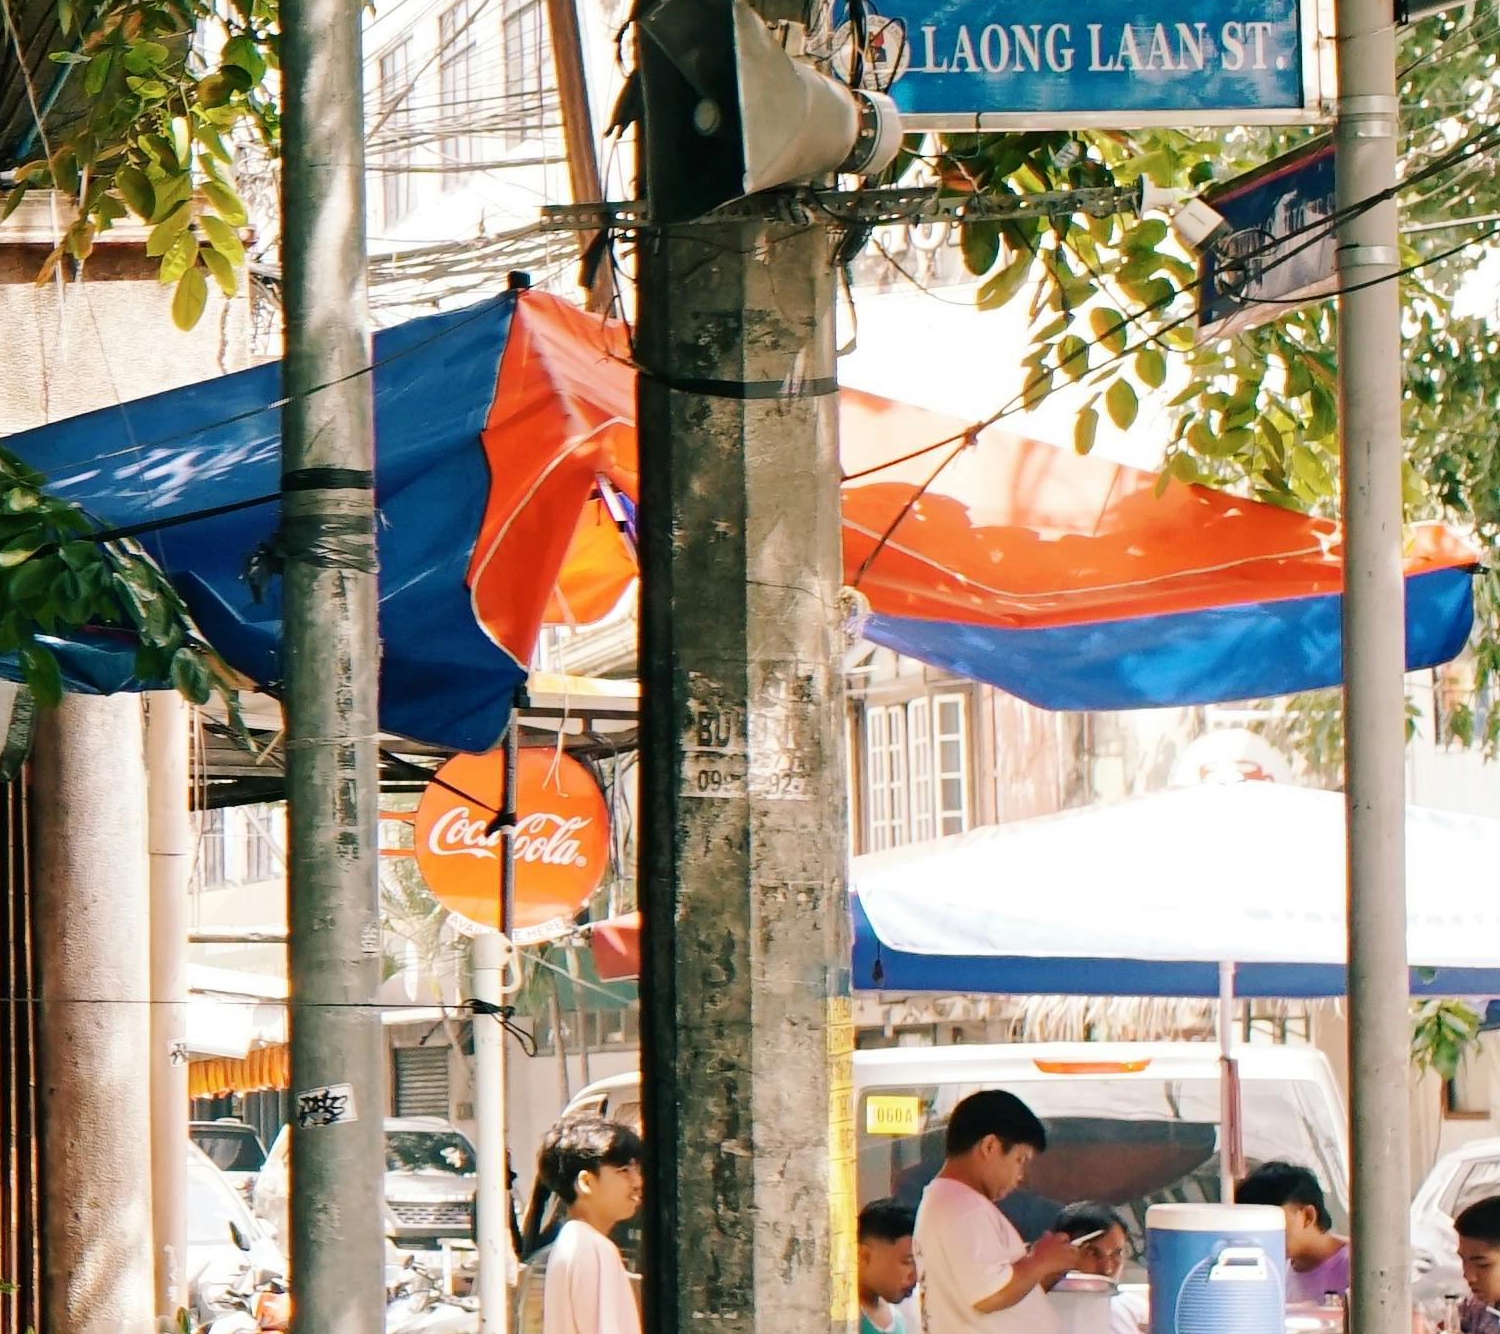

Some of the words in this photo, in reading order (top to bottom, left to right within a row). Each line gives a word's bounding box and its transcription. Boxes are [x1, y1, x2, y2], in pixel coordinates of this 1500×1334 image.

[921, 22, 1076, 73] LAONG
[1087, 22, 1206, 72] LAAN
[1221, 20, 1285, 71] ST.
